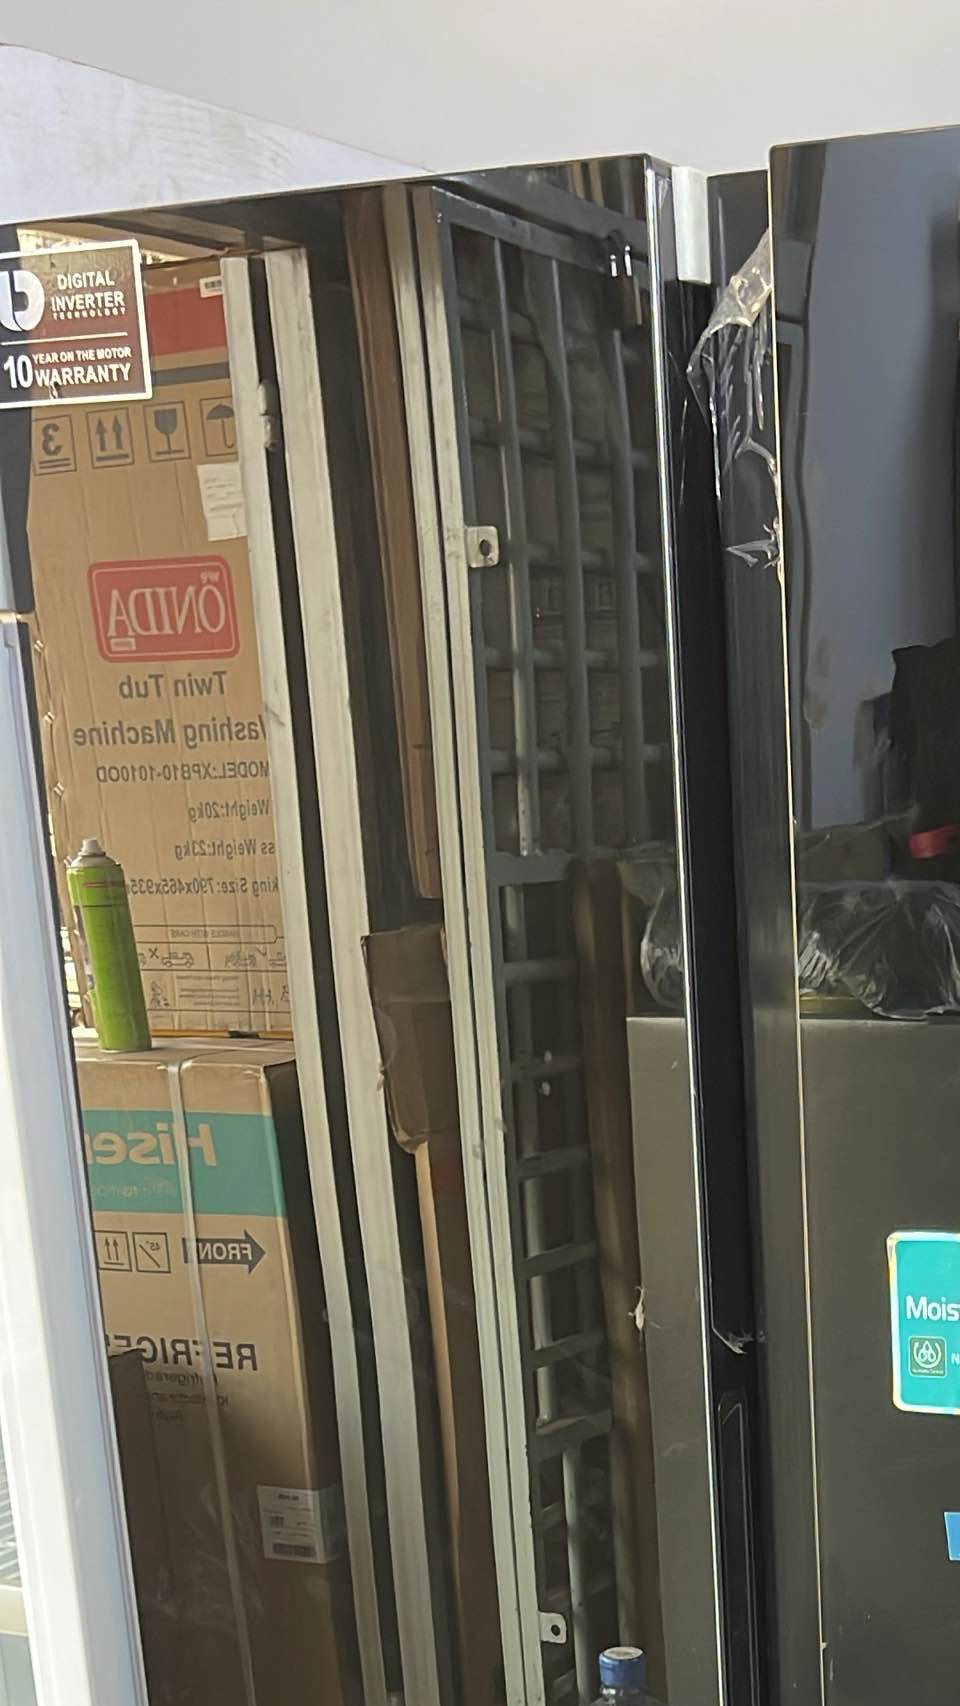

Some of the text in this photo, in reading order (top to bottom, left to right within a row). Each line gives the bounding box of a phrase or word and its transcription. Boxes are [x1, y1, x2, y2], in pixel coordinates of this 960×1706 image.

[57, 270, 115, 290] DIGITAL
[51, 290, 125, 312] INVERTER
[32, 346, 132, 365] YEAR ON THE MOTOR
[3, 354, 34, 389] 10
[34, 362, 131, 387] WARRANTY
